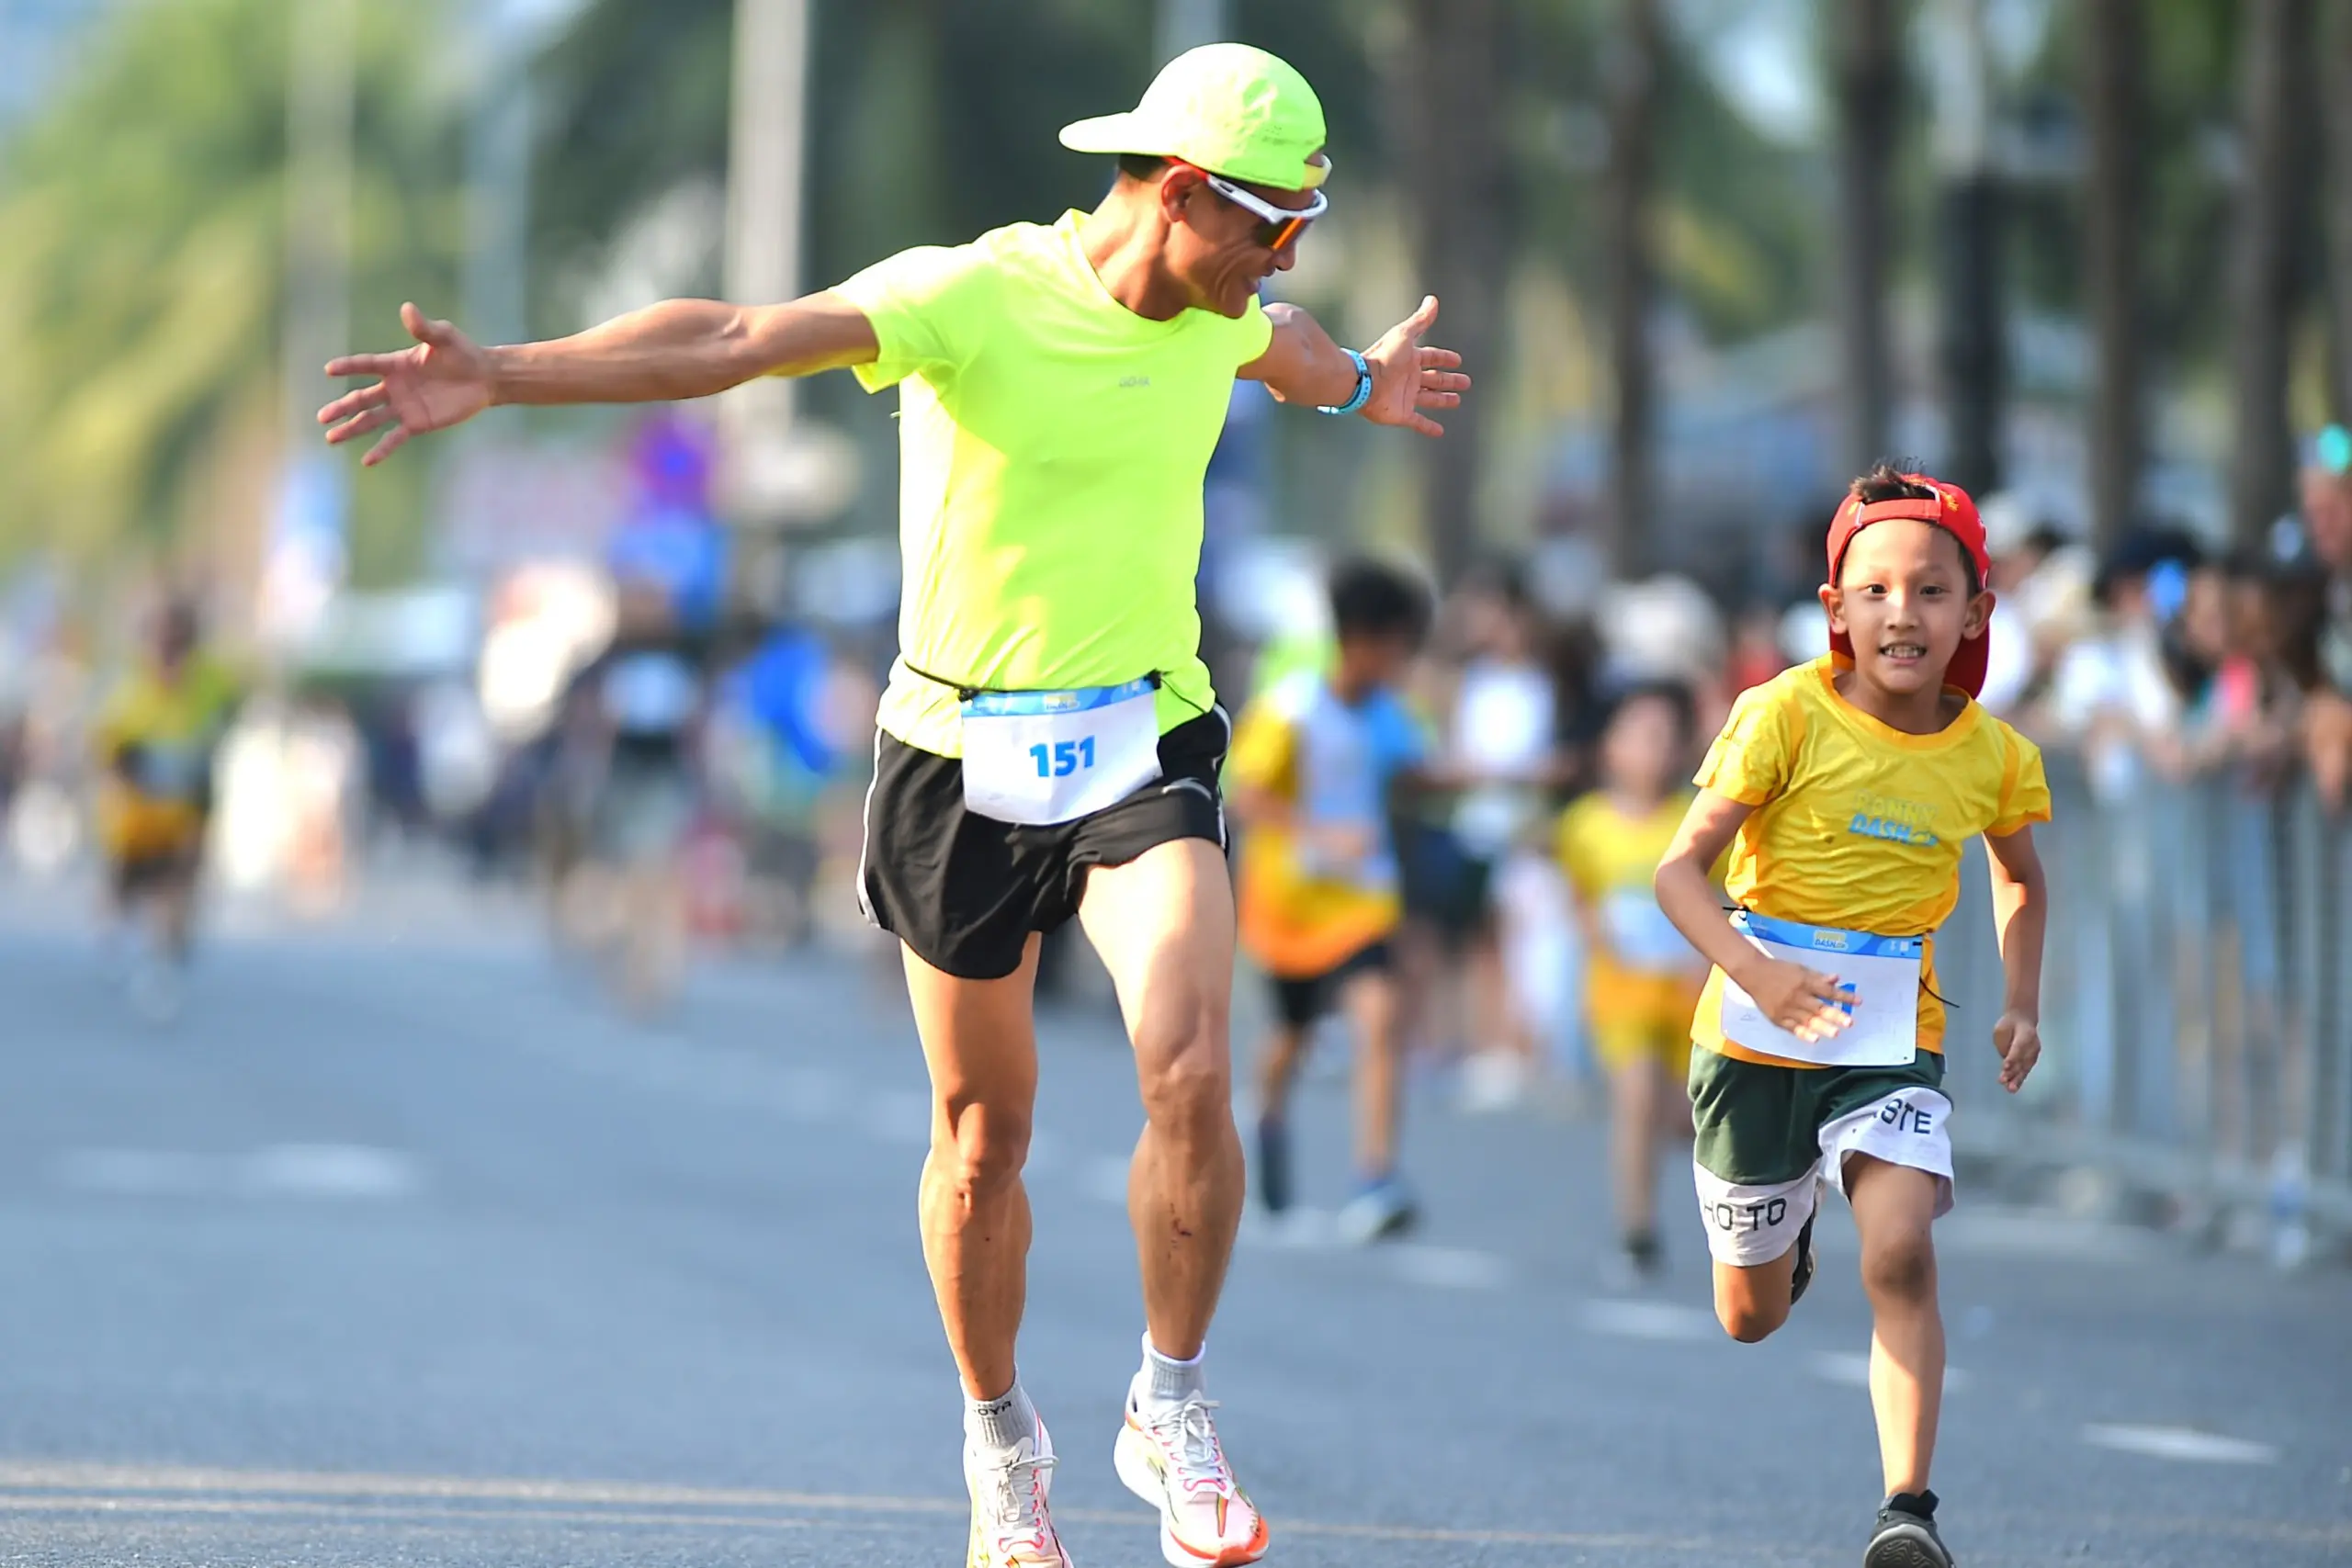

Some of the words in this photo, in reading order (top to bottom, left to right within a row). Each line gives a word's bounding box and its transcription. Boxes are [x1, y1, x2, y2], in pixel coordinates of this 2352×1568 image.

[1029, 736, 1095, 777] 151
[1848, 813, 1912, 844] DASH
[1873, 1098, 1932, 1134] STE
[973, 1400, 1012, 1416] OYA
